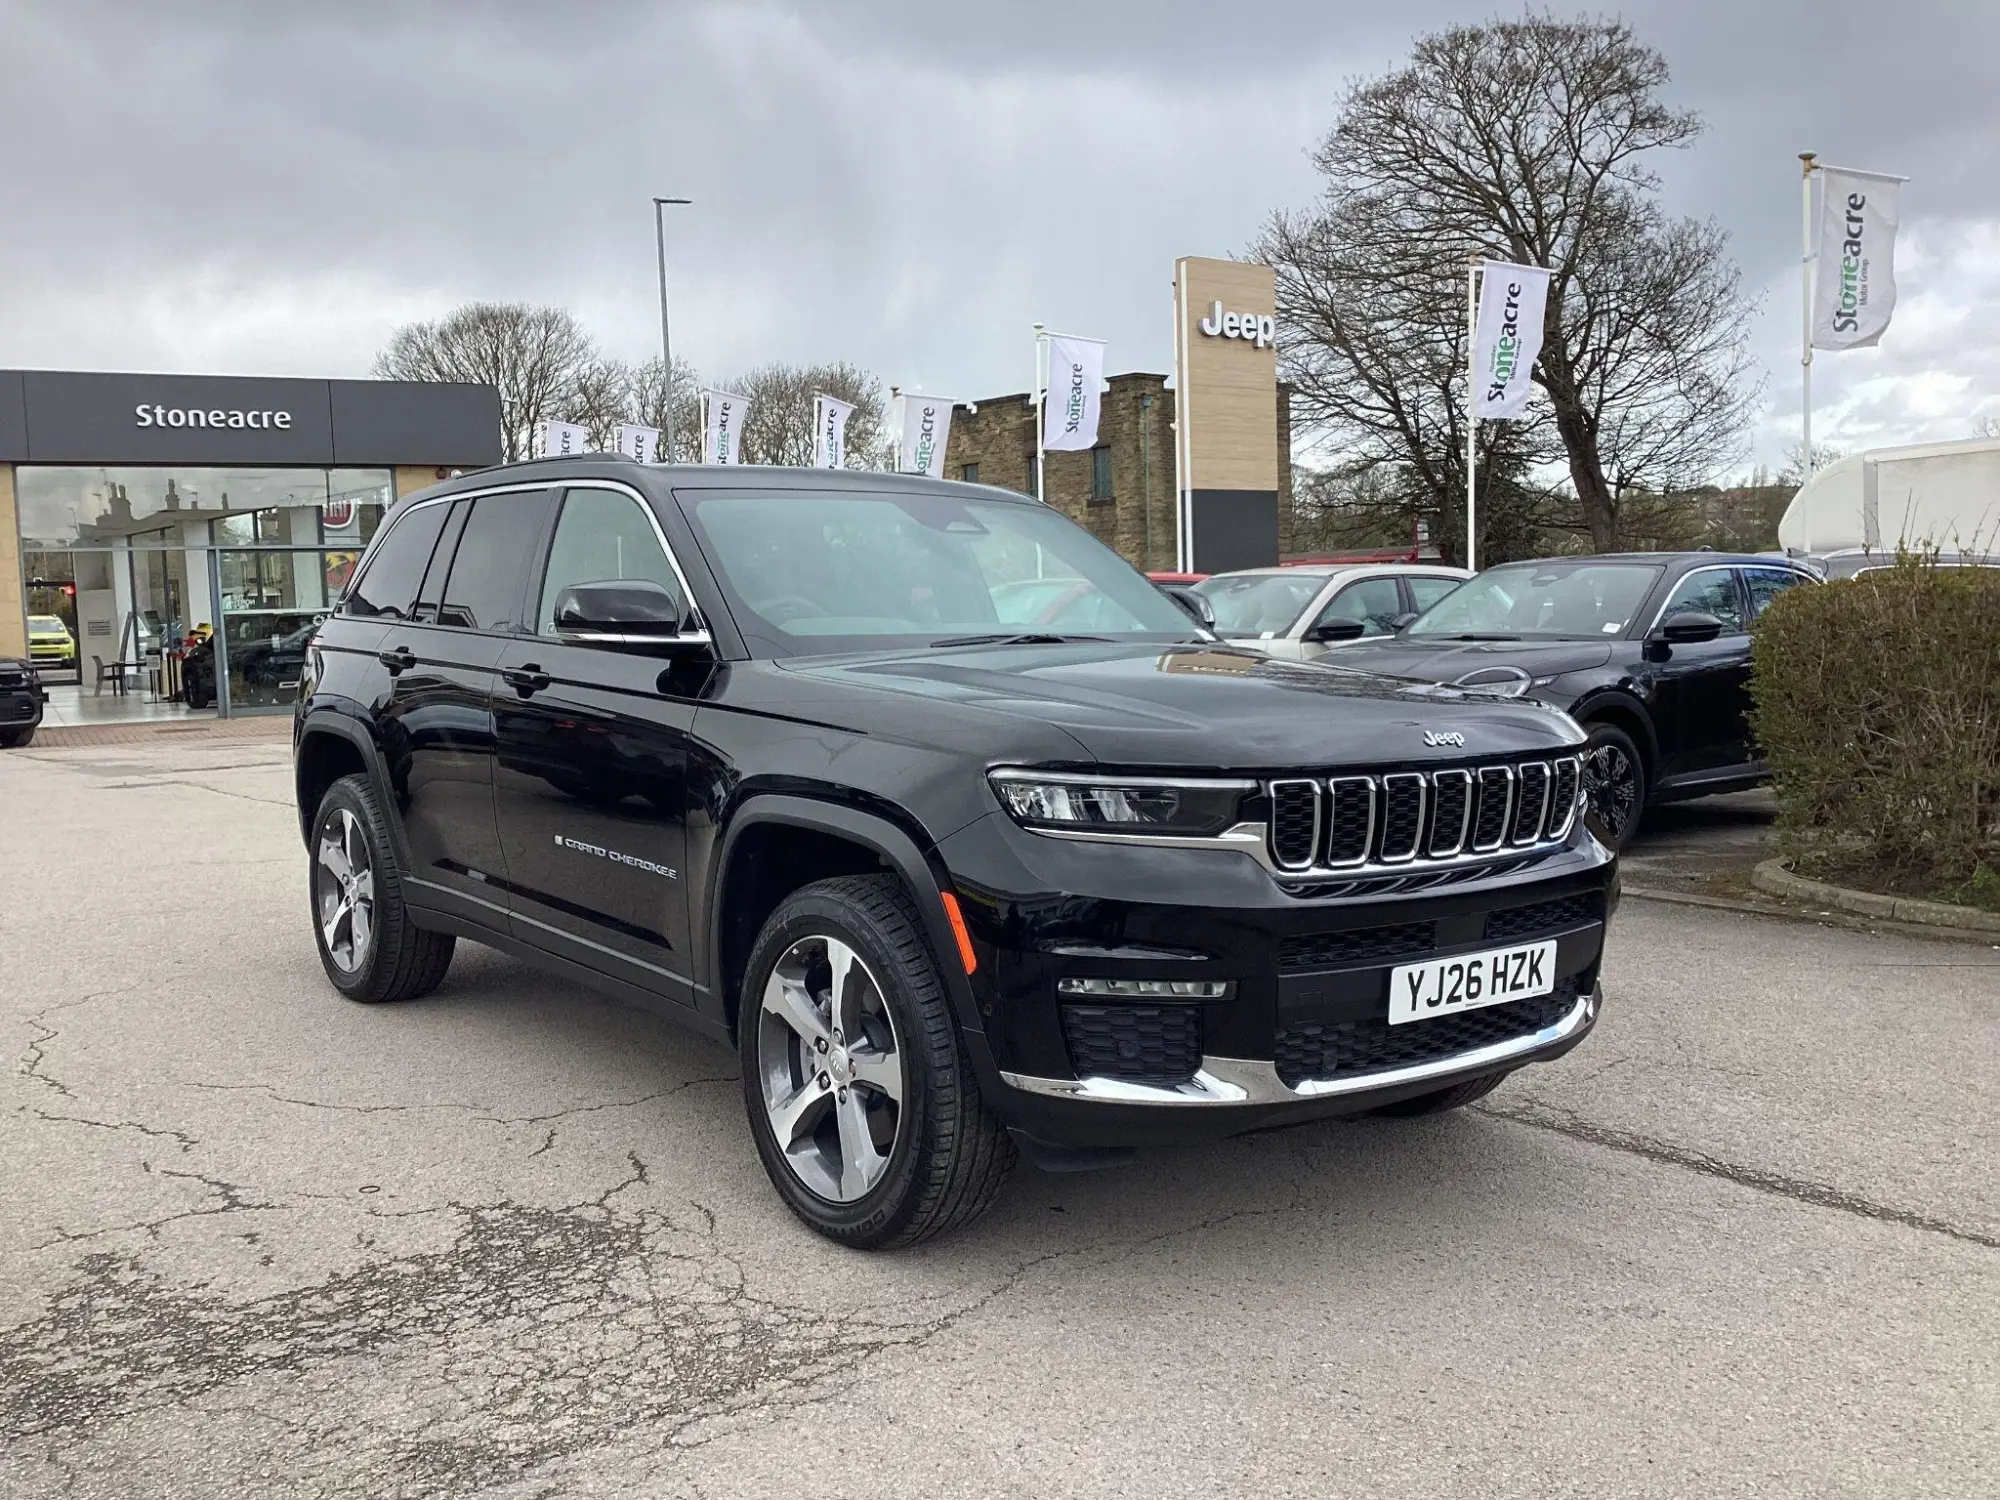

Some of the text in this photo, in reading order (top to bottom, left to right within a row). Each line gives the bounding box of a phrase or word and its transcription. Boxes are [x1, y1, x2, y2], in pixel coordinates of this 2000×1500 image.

[1832, 192, 1866, 332] Stoneacre
[1200, 299, 1275, 348] Jeep
[1487, 282, 1522, 402] Stoneacre
[135, 403, 292, 429] Stoneacre
[1065, 363, 1083, 433] Stoneacre
[634, 434, 645, 464] acre
[1423, 730, 1466, 748] Jeep
[564, 838, 677, 879] GRAND CHEROKEE
[1407, 948, 1546, 1012] YJ26 HZK
